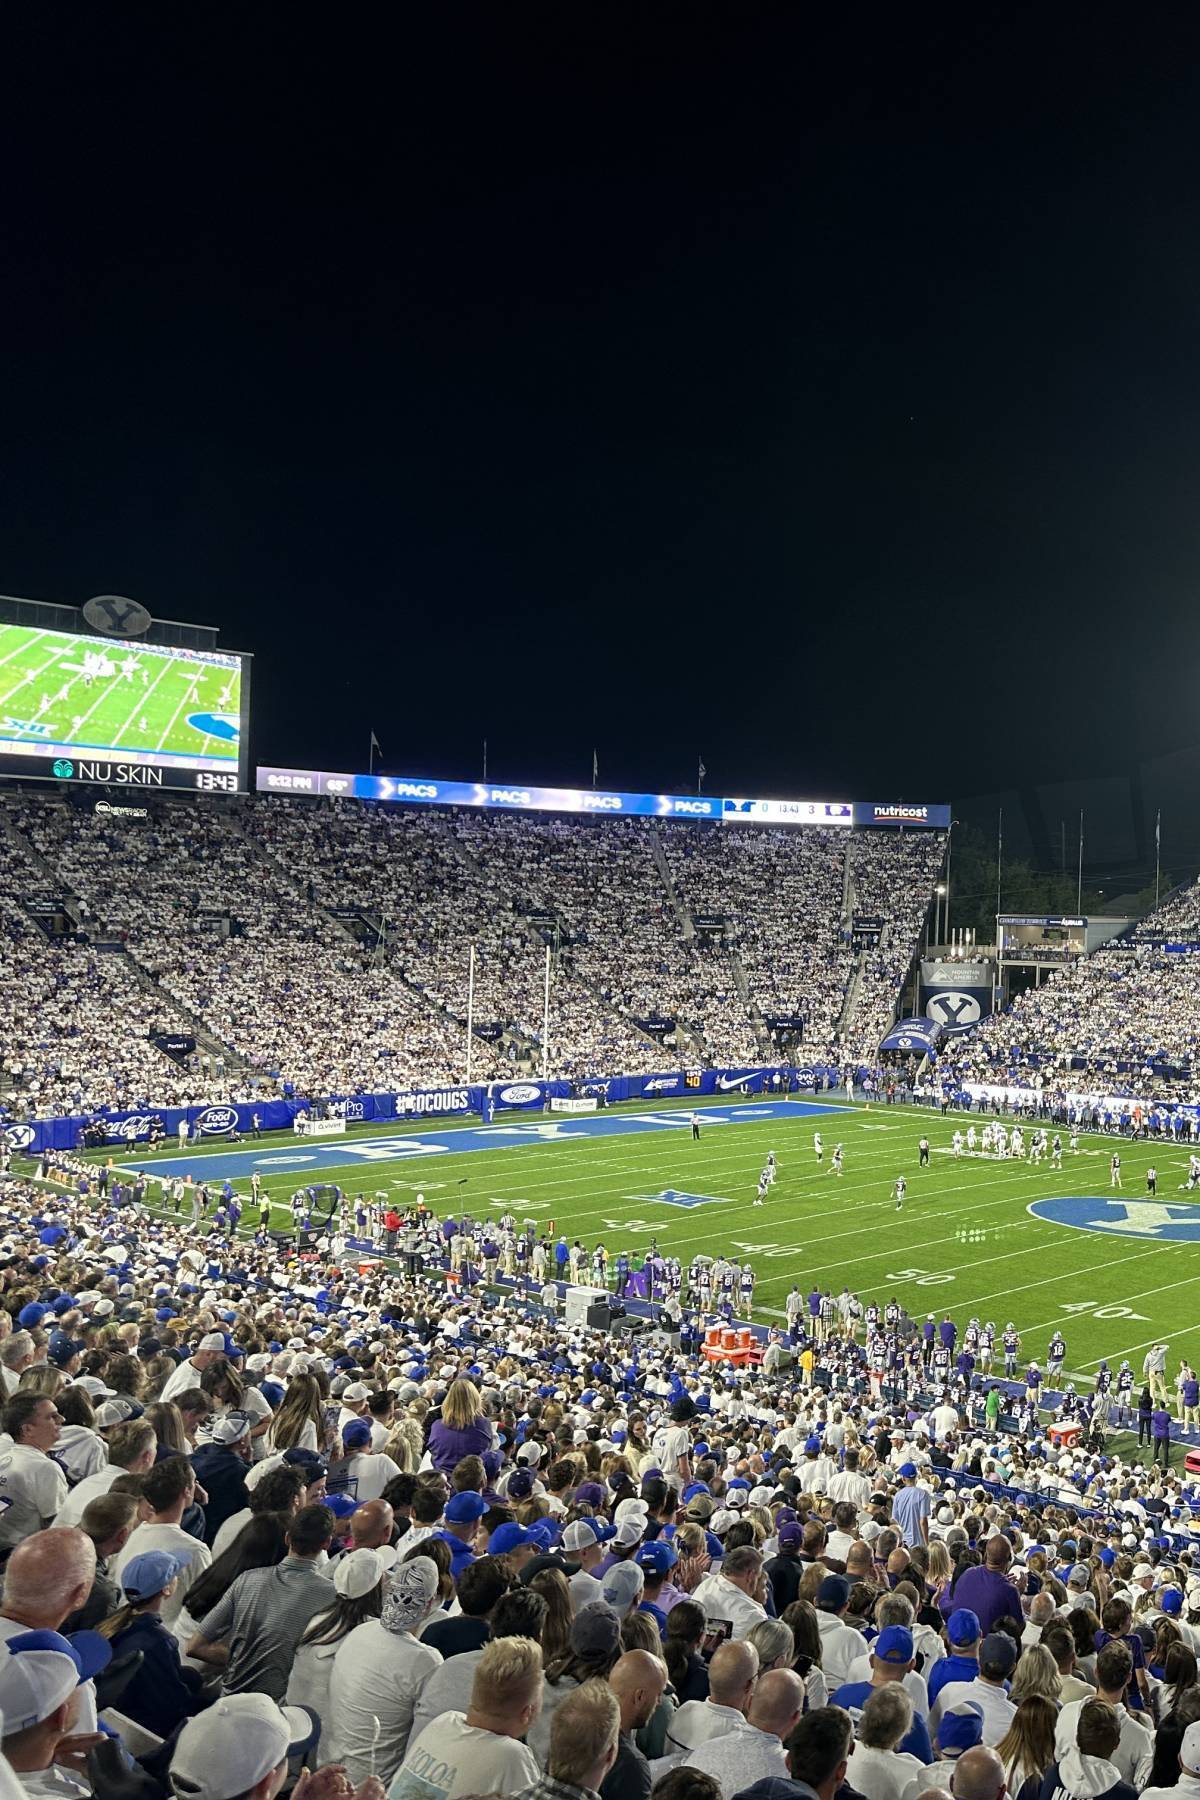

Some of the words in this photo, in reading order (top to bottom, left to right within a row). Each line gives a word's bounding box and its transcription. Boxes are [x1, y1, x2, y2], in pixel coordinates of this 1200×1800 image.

[96, 599, 142, 633] Y
[79, 762, 111, 781] NU
[117, 764, 163, 785] SKIN
[196, 773, 238, 791] 13:43
[397, 783, 437, 798] PACS
[491, 790, 530, 804] PACS
[584, 796, 623, 809] PACS
[674, 800, 712, 814] PACS
[808, 805, 815, 815] 3
[874, 805, 928, 819] nutricost
[932, 997, 973, 1025] Y
[686, 1077, 700, 1087] 40
[509, 1087, 532, 1100] Ford
[206, 1110, 231, 1123] Food
[8, 1128, 30, 1146] Y
[885, 1269, 956, 1286] 50
[1058, 1301, 1133, 1320] 40
[1053, 1345, 1064, 1356] 18
[1121, 1376, 1133, 1387] 25
[406, 1746, 458, 1788] KOLOA
